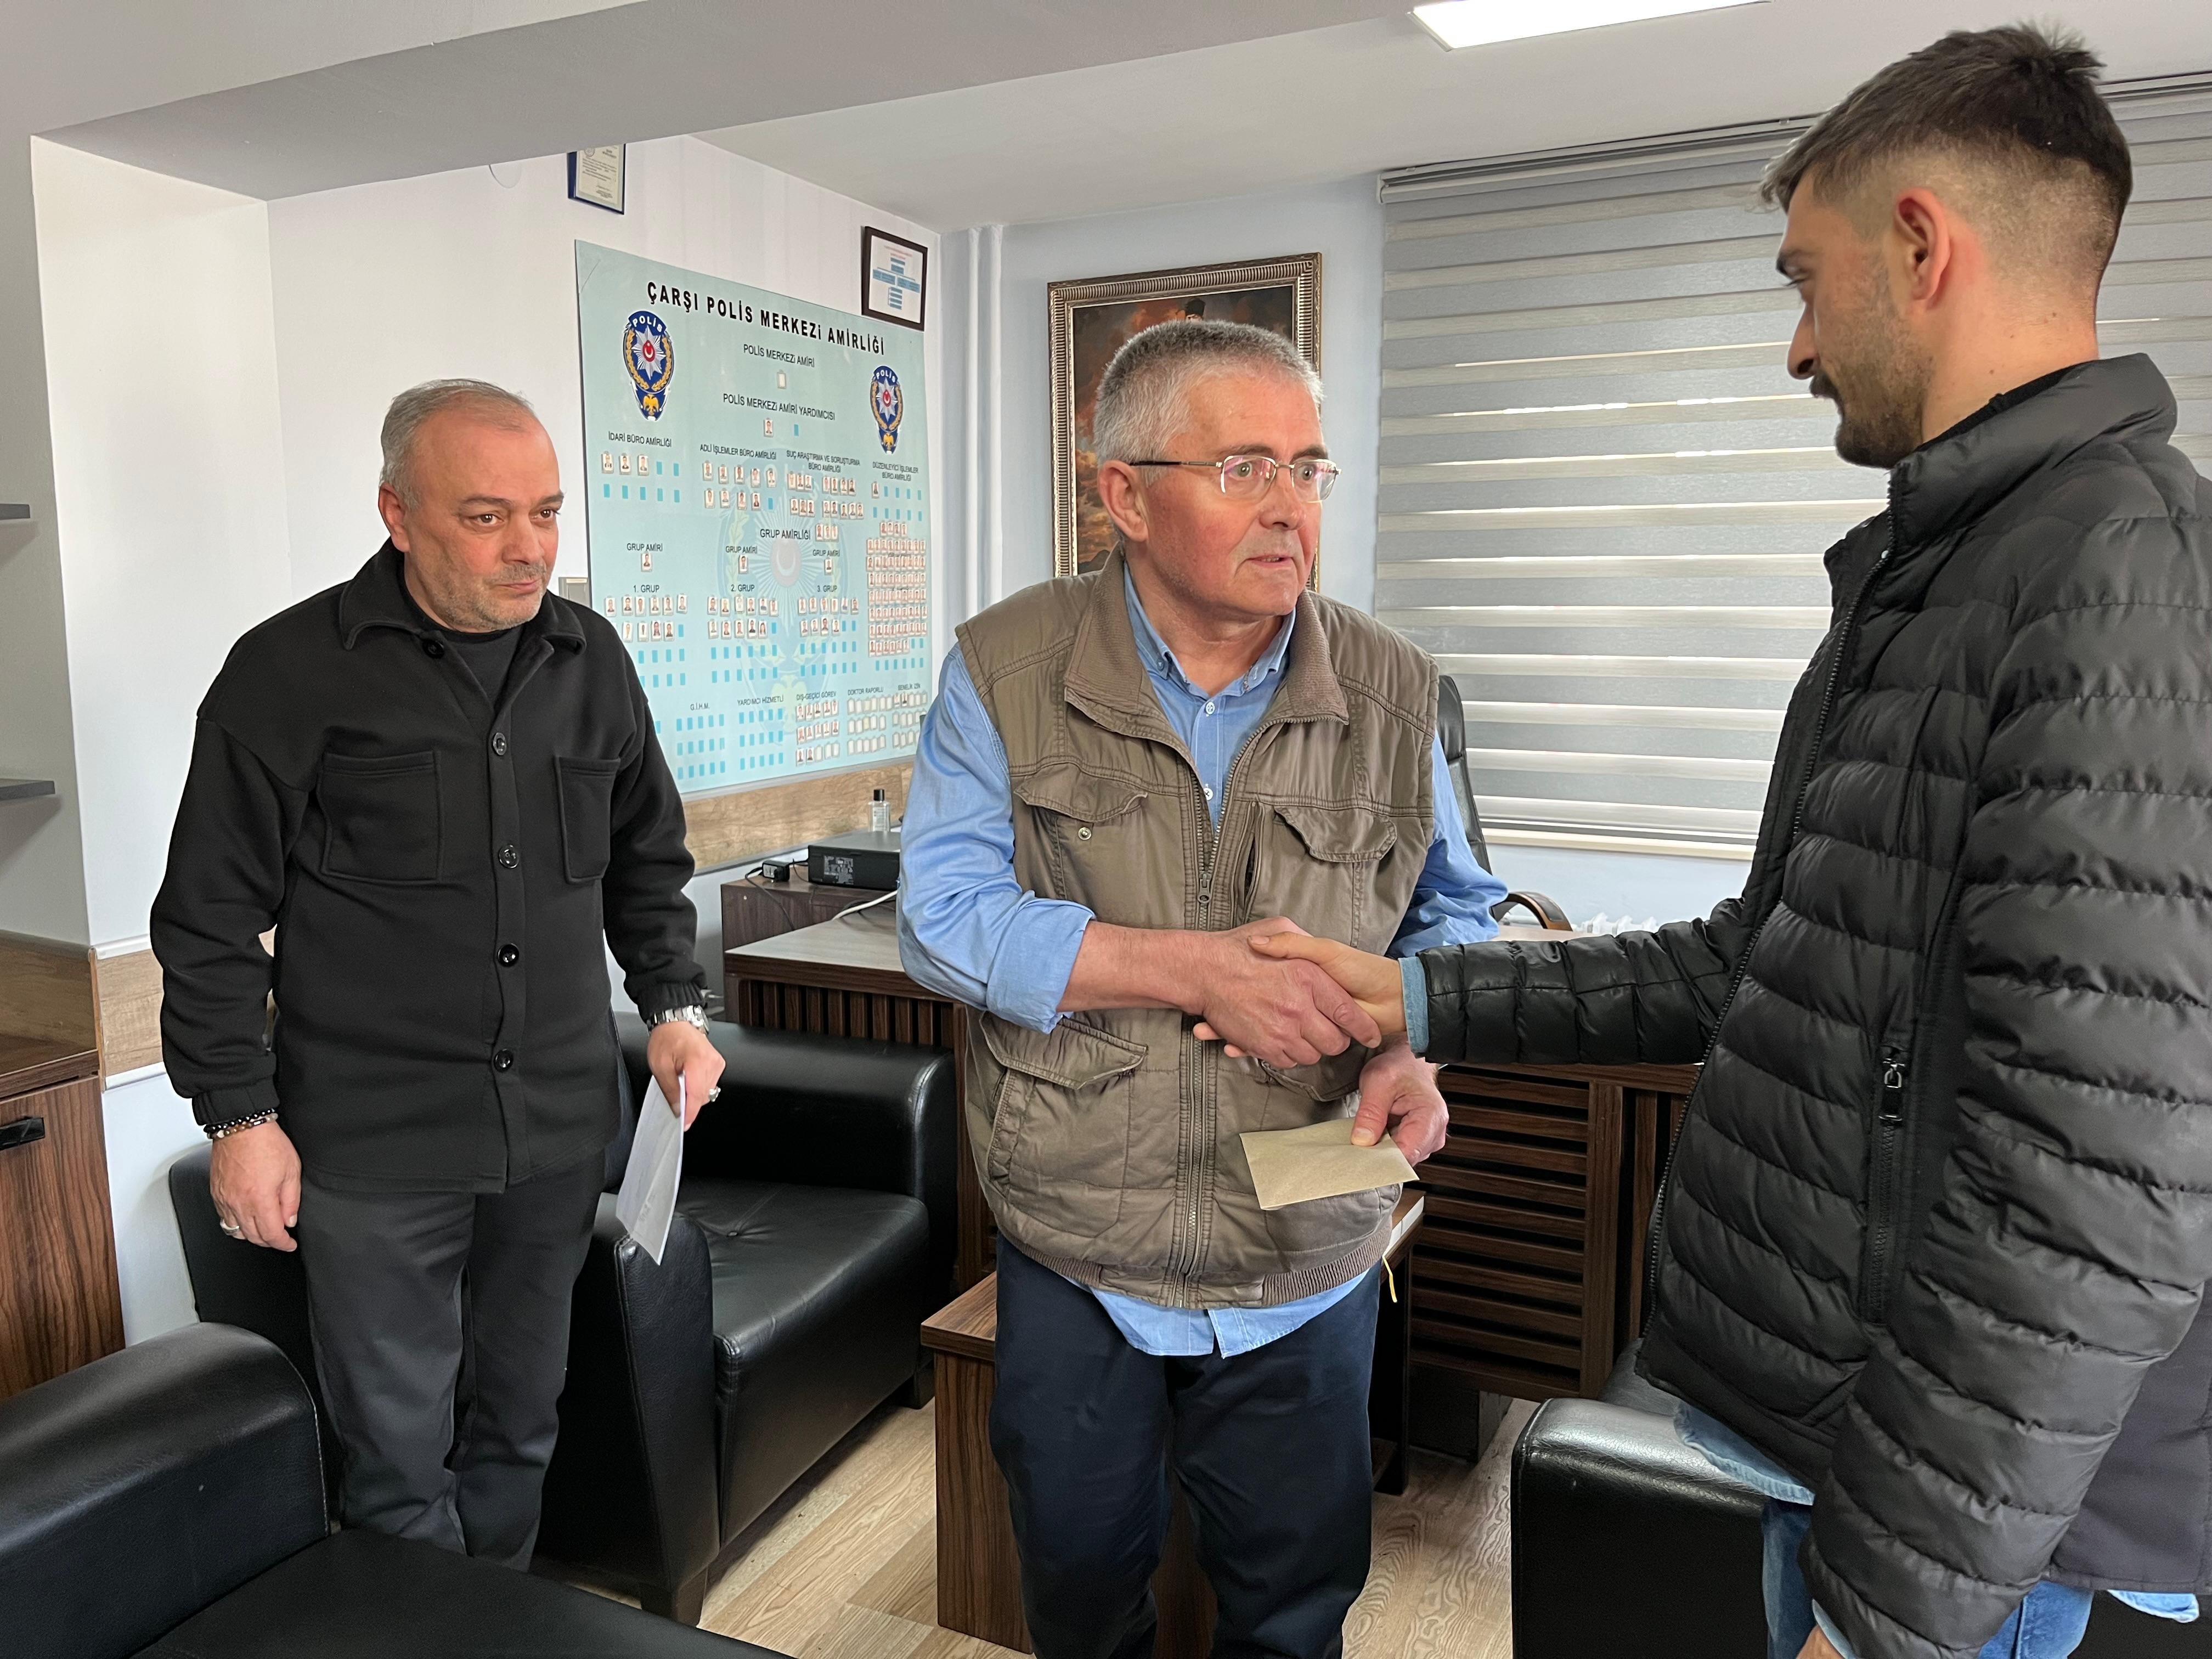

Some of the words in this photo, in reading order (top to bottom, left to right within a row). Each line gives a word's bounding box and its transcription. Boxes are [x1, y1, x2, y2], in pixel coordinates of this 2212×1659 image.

[647, 281, 698, 313] ÇARŞI
[707, 296, 753, 323] POLİS
[828, 328, 884, 356] AMİRLİĞİ
[743, 344, 764, 357] POLİS
[797, 356, 815, 368] AMİRİ
[723, 393, 744, 405] POLİS
[778, 403, 797, 414] AMİRİ
[799, 406, 836, 420] YARDIMCISI
[608, 431, 625, 442] İDARİ
[627, 435, 645, 444] BÜRO
[646, 437, 672, 447] AMİRLİĞİ
[700, 444, 712, 452] ADLİ
[713, 444, 738, 455] İŞLEMLER
[740, 448, 754, 458] BÜRO
[786, 450, 796, 459] SUÇ
[808, 462, 821, 471] BÜRO
[760, 528, 780, 538] GRUP
[781, 529, 811, 540] AMİRLİĞİ
[627, 543, 645, 551] GRUP
[646, 543, 663, 551] AMİRİ
[742, 545, 758, 554] AMİRİ
